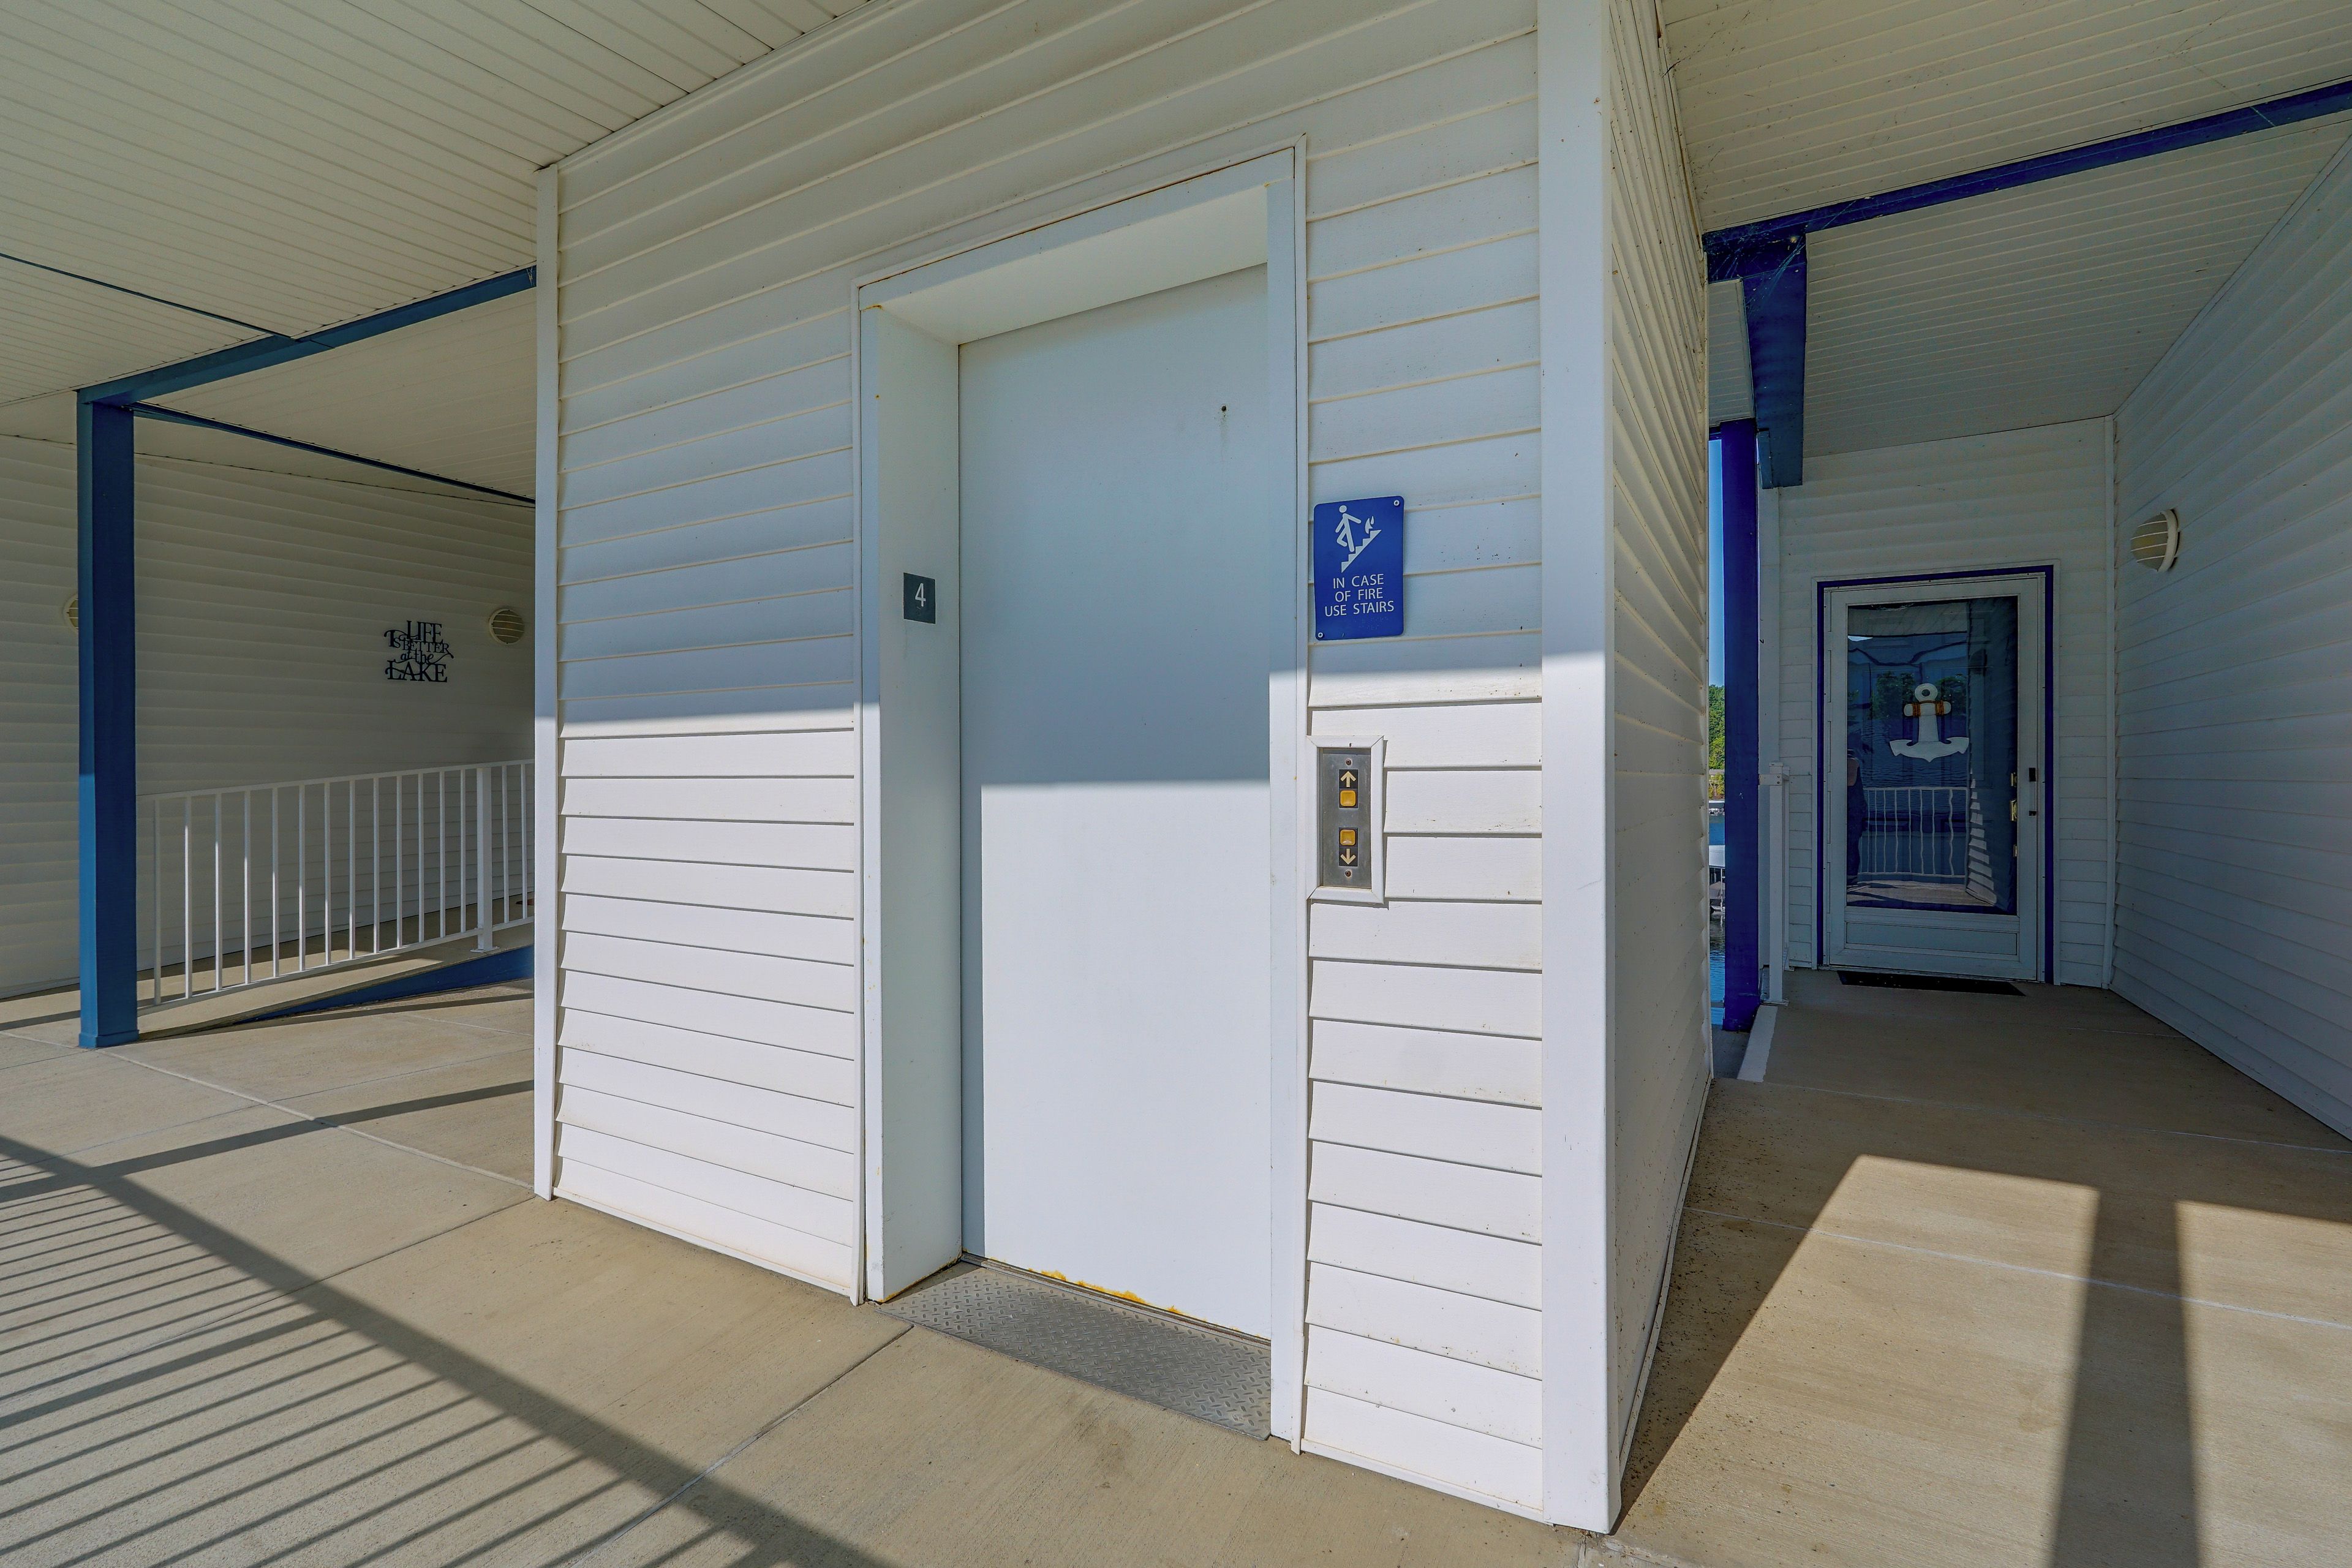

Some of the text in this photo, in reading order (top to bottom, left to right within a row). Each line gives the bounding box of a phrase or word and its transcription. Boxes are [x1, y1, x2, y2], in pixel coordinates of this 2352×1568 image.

[1333, 573, 1384, 589] IN CASE
[915, 583, 925, 606] 4
[1335, 587, 1384, 603] OF FIRE
[1325, 600, 1395, 617] USE STAIRS
[404, 620, 442, 643] LIFE
[402, 640, 451, 654] BETTER
[415, 650, 434, 665] the
[385, 660, 448, 683] LAKE
